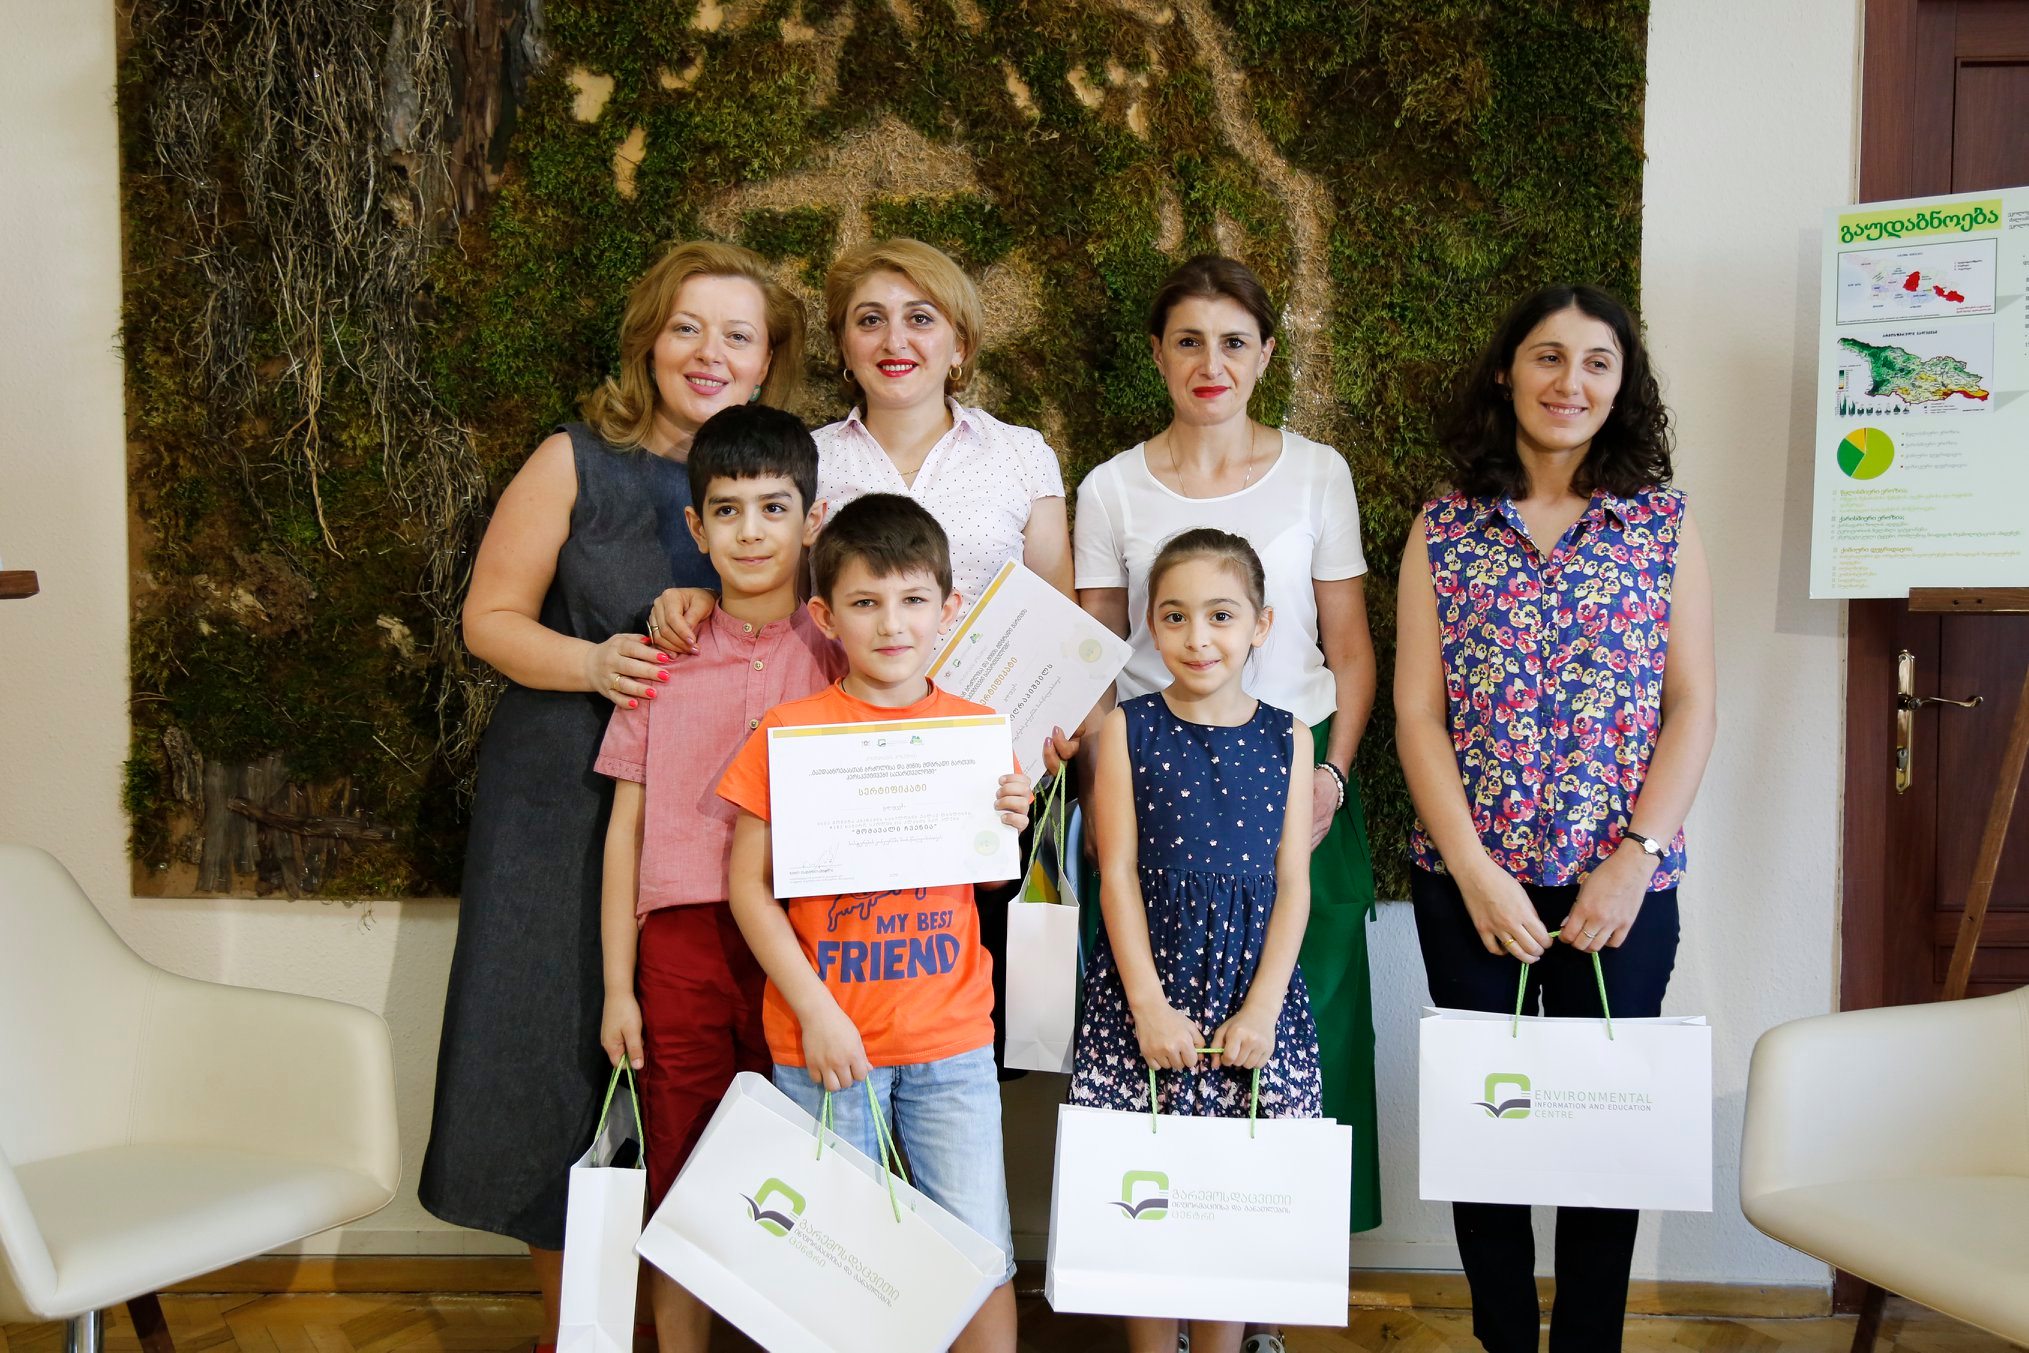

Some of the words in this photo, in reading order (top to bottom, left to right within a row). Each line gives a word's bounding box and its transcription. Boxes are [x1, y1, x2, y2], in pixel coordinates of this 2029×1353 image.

[1841, 208, 1999, 244] გაუდაბნოება
[979, 657, 1018, 706] ერტიფიკატი
[858, 783, 927, 796] სერტიფიკატი
[877, 913, 909, 934] MY
[818, 933, 961, 984] FRIEND
[1534, 1089, 1654, 1104] ENVIRONMENTAL
[1534, 1101, 1586, 1109] INFORMATION
[1589, 1103, 1605, 1111] AND
[1607, 1104, 1651, 1112] EDUCATION
[1534, 1109, 1574, 1119] CENTRE
[1172, 1188, 1292, 1205] გარემოსდაცვითი
[1171, 1211, 1215, 1222] ცენტრი
[788, 1236, 826, 1267] ცენტრი
[798, 1218, 900, 1300] გარემოსდაცვითი
